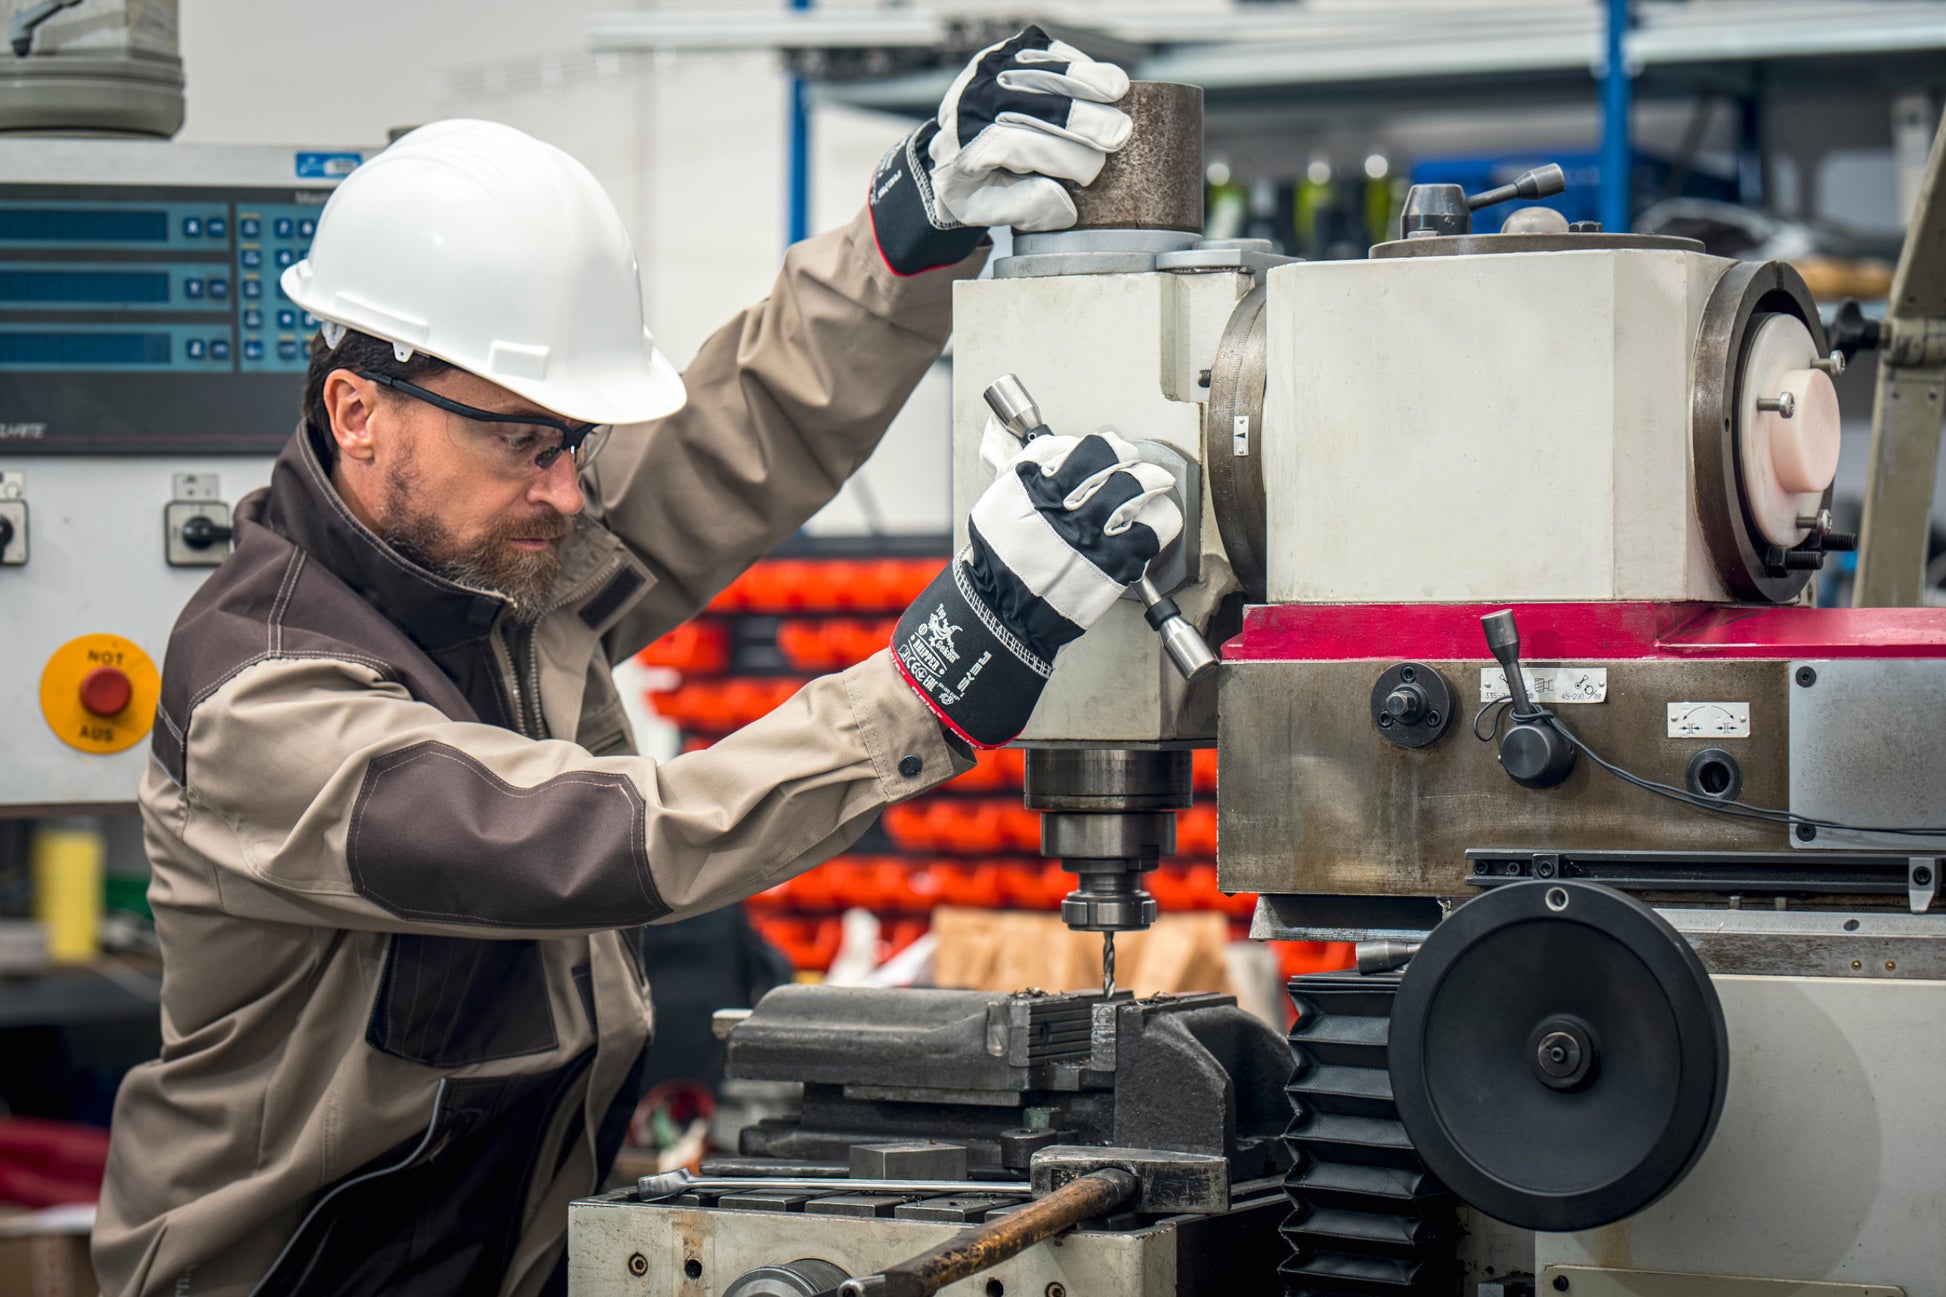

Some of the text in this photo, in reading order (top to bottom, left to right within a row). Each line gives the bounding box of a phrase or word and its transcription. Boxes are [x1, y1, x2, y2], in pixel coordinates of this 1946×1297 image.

[88, 650, 125, 665] NOT
[913, 638, 940, 671] RHIPPER
[935, 640, 956, 664] Gekon
[79, 726, 115, 743] AUS
